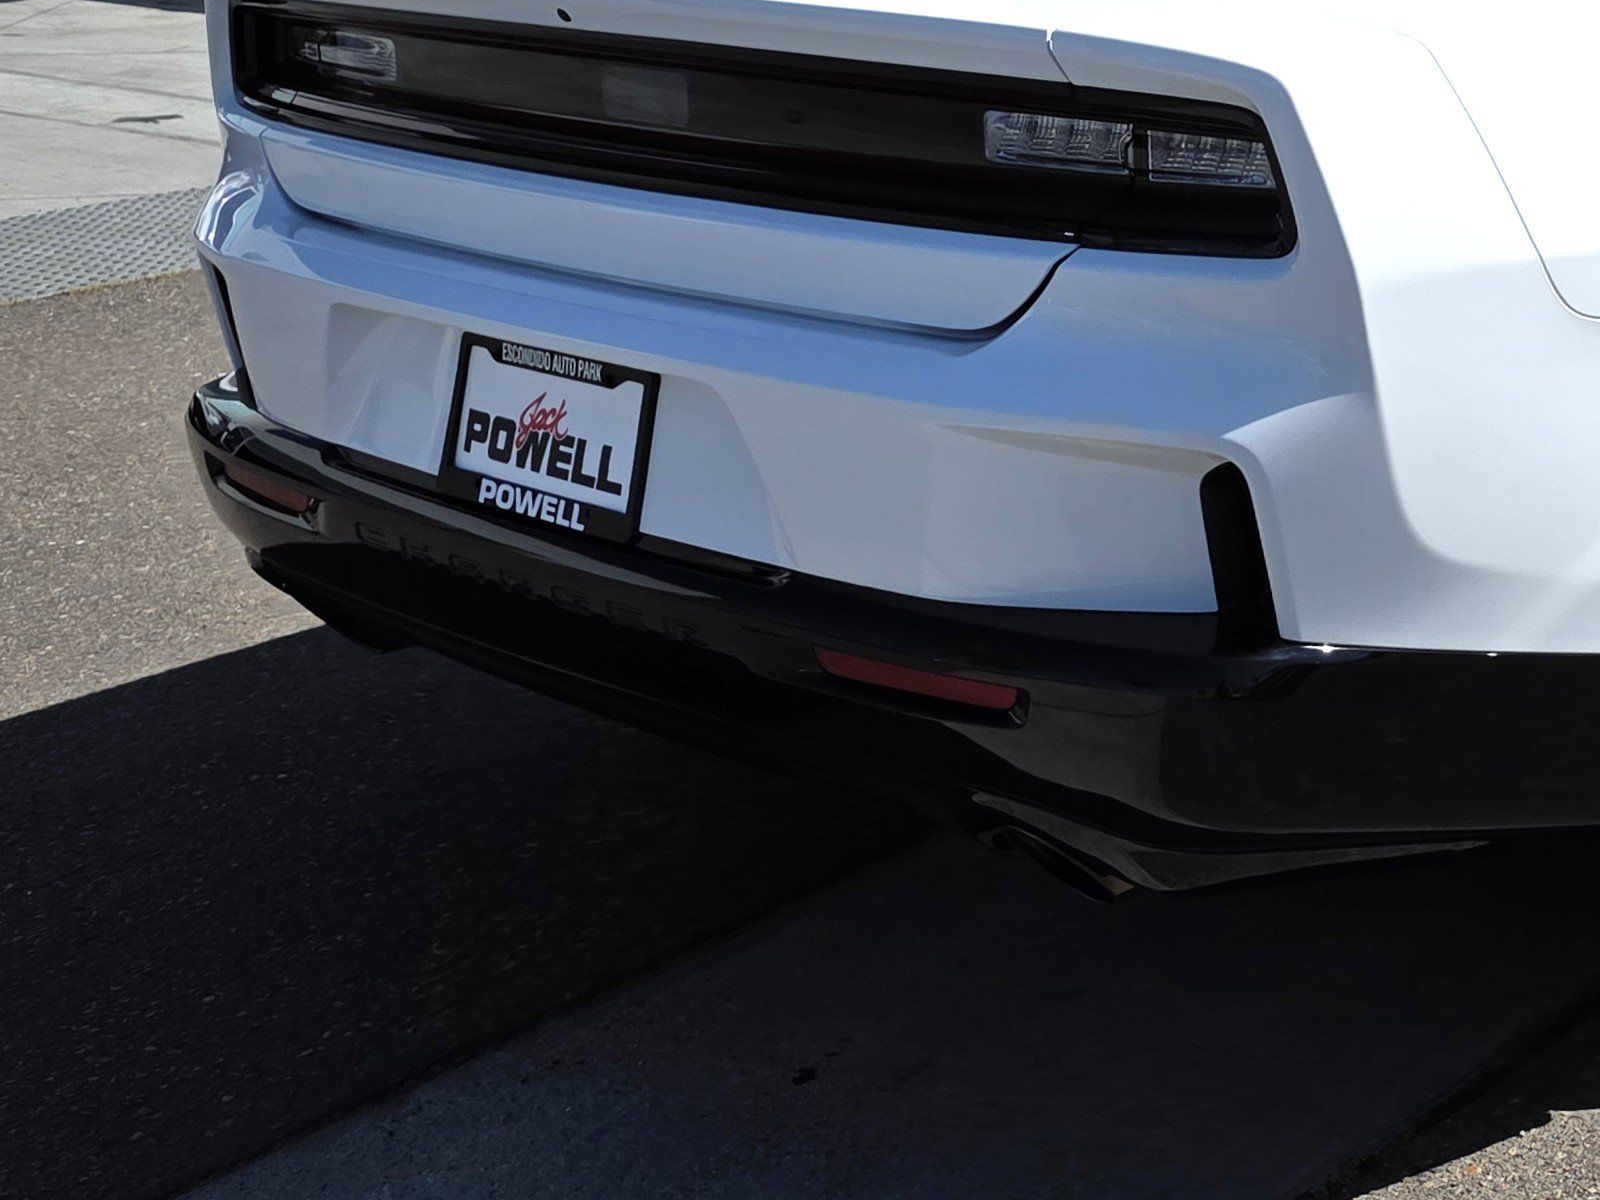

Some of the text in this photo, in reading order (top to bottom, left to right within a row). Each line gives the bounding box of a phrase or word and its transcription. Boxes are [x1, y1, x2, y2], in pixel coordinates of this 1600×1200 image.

[552, 356, 577, 377] AUTO
[577, 360, 603, 383] PARK
[515, 391, 569, 449] Jack
[464, 408, 623, 496] POWELL
[478, 478, 585, 532] POWELL
